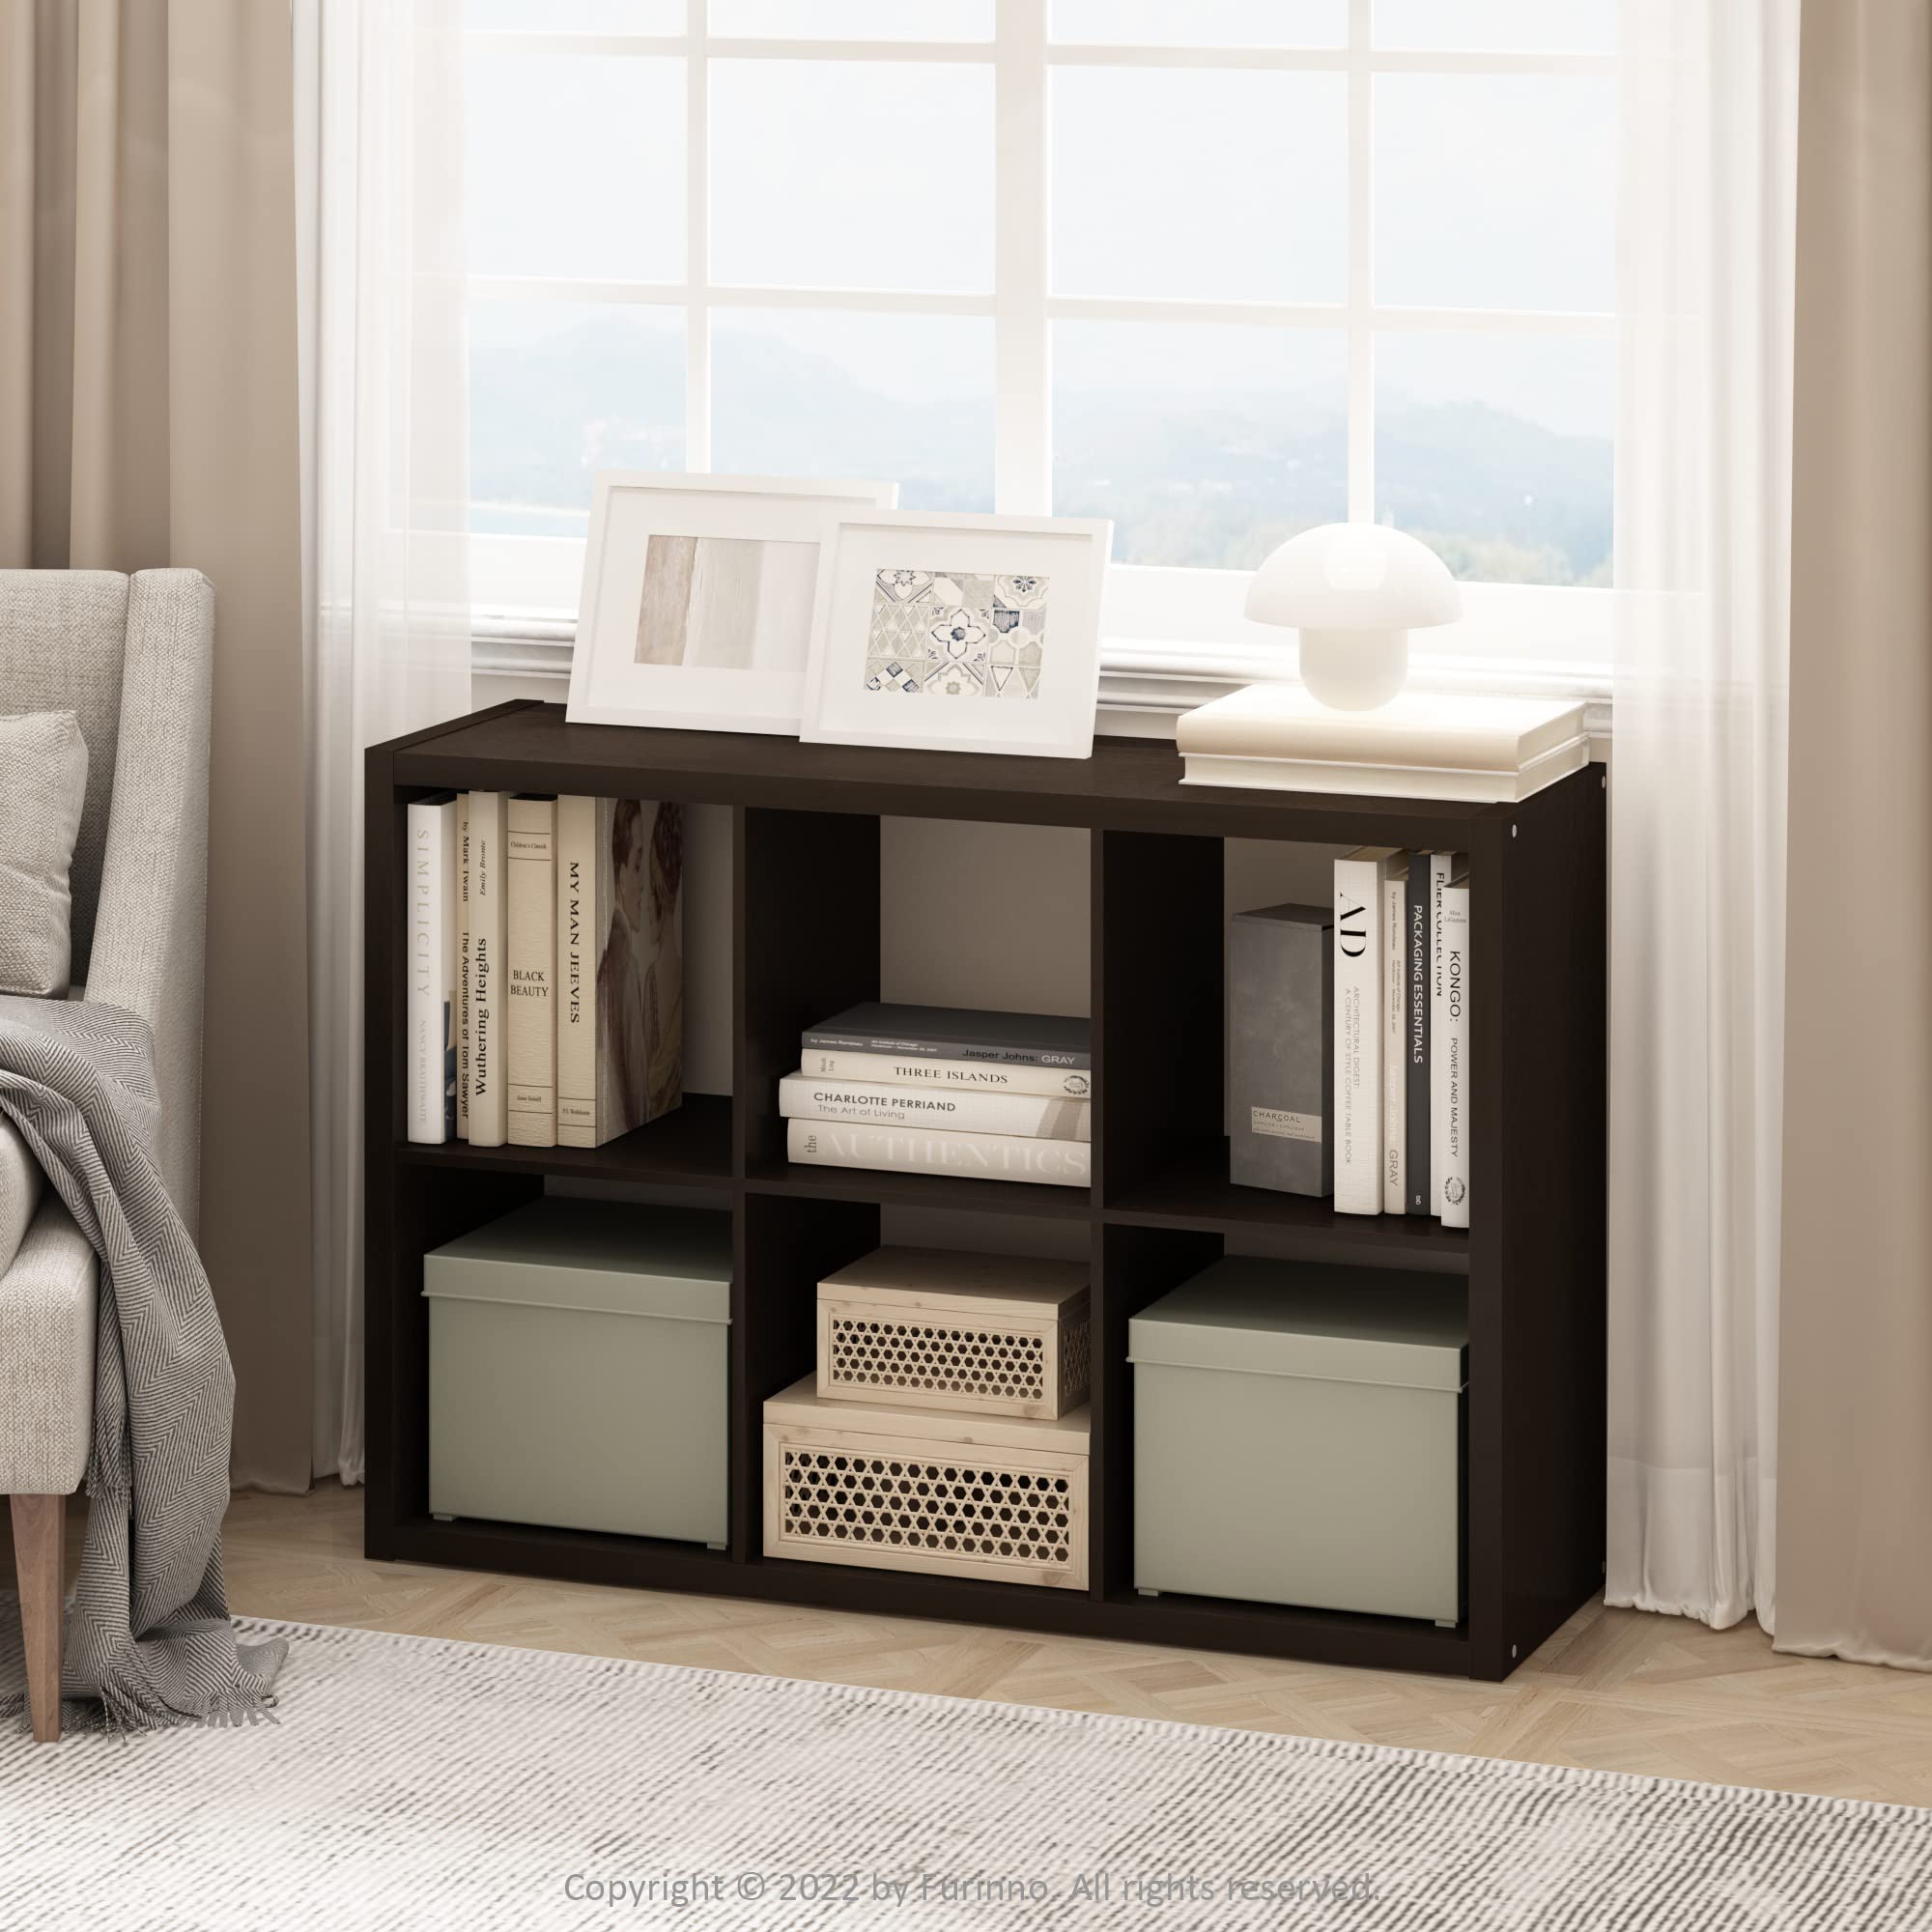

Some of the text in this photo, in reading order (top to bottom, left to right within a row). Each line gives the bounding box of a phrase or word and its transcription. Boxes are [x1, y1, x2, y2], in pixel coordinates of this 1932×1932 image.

[479, 872, 488, 896] Emily
[416, 829, 431, 997] SIMPLICITY
[1339, 892, 1367, 957] AD
[569, 862, 580, 1024] MY MAN JEEVES
[513, 969, 545, 981] BLACK
[1413, 905, 1423, 1064] PACKAGING ESSENTIALS
[1449, 951, 1462, 1022] KONGO:
[510, 984, 549, 997] BEAUTY
[475, 938, 490, 1097] Wuthering Heights
[962, 1049, 1075, 1065] Jasper Johns: GRAY
[1345, 1038, 1351, 1050] OF
[894, 1066, 1008, 1084] THREE ISLANDS
[460, 1073, 469, 1120] Sawyer
[813, 1092, 956, 1112] CHARLOTTE PERRIAND
[874, 1110, 905, 1121] Living
[1252, 1110, 1301, 1123] CHARCOAL
[804, 1133, 1087, 1176] the AUTHENTICS
[1389, 1150, 1399, 1186] GRAY
